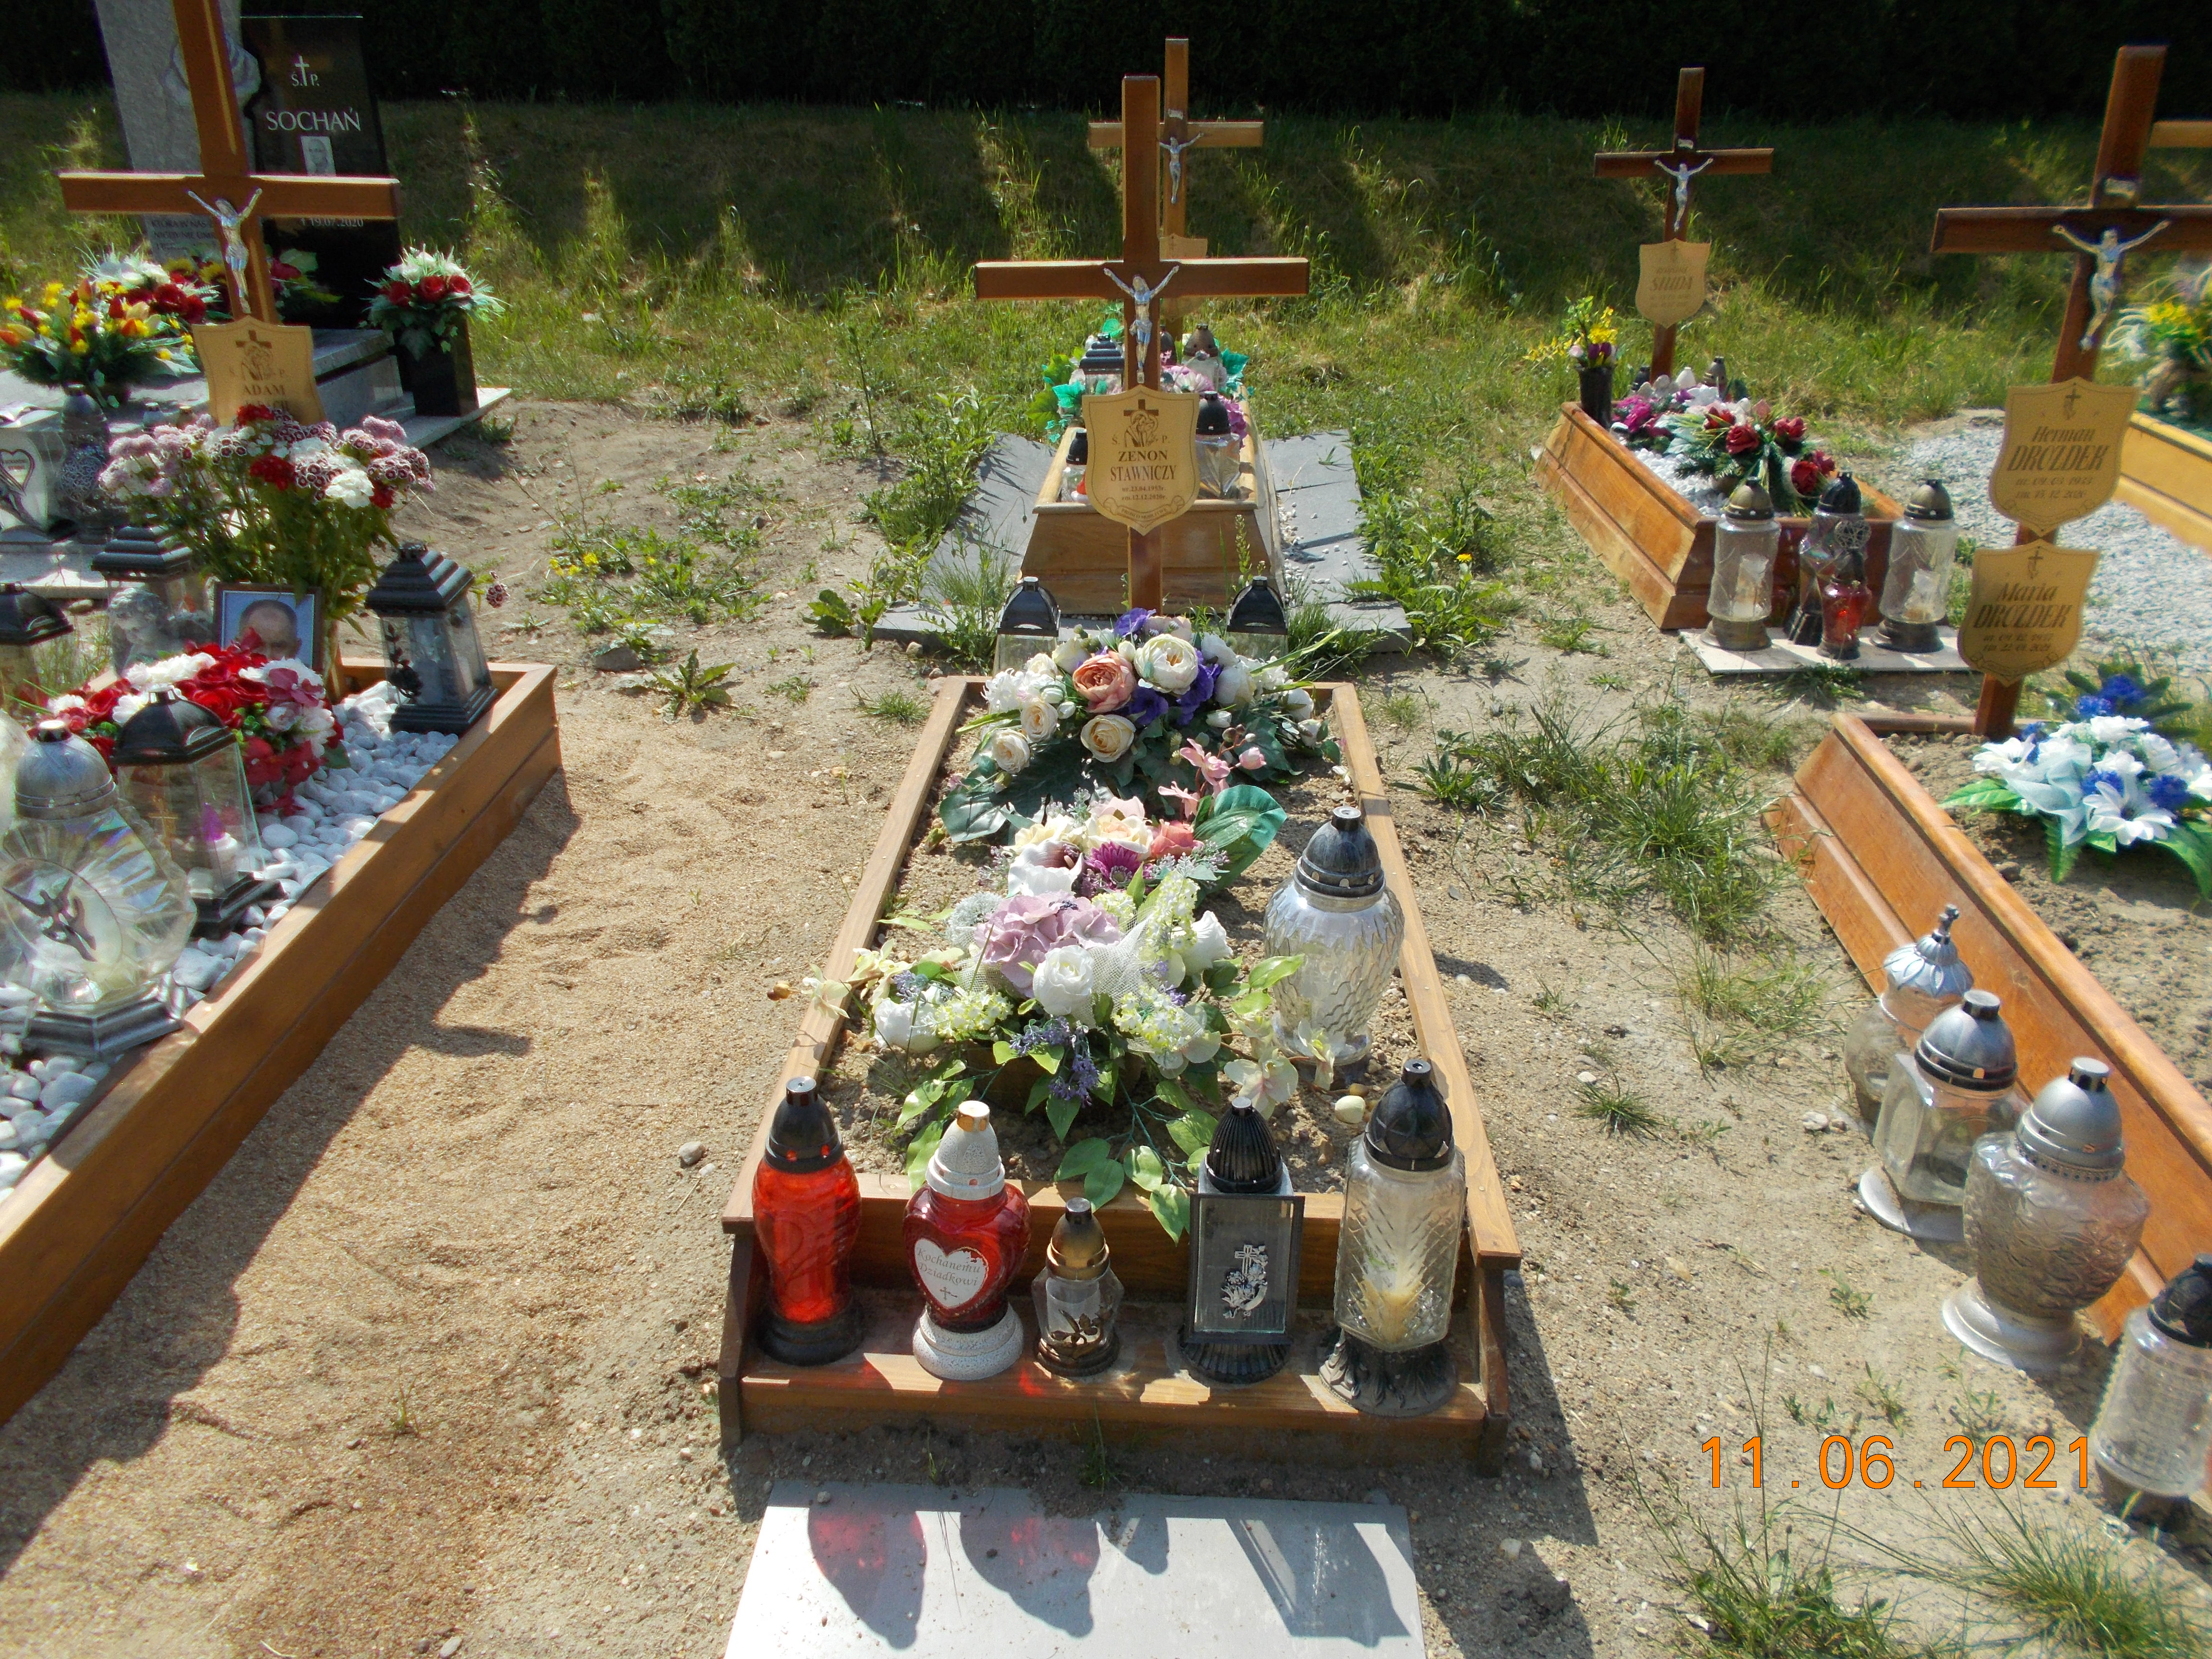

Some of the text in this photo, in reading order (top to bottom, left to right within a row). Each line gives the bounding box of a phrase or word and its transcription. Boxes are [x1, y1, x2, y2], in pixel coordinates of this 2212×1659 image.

[310, 73, 320, 86] P.
[265, 108, 361, 131] SOCHAŃ
[243, 384, 286, 396] ADAM
[2031, 425, 2096, 443] Herman
[1118, 450, 1168, 462] ZENON
[2007, 444, 2110, 471] DROZDEK
[1110, 465, 1177, 481] STAWNICZY
[1996, 582, 2058, 601] Maria
[1972, 603, 2073, 628] DROZDEK
[917, 1247, 981, 1273] Kochanemu
[918, 1262, 978, 1286] Dziadkowi
